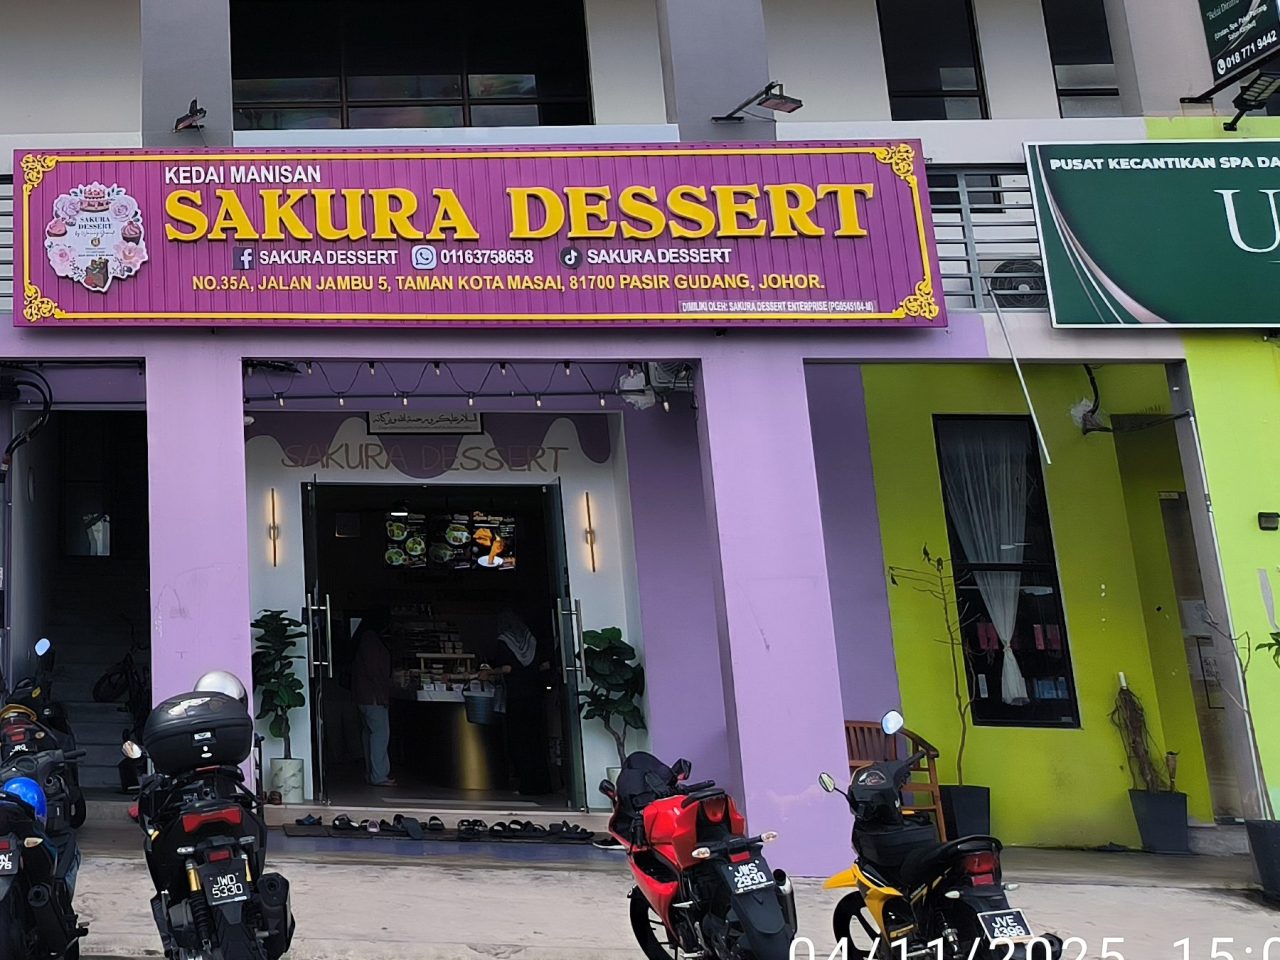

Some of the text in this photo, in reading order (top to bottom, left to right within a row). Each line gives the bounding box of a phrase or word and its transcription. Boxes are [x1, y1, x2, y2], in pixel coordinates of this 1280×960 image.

[1226, 30, 1277, 68] 018 771 9442
[1050, 158, 1104, 170] PUSAT
[1108, 157, 1216, 169] KECANTIKAN
[1219, 156, 1254, 168] SPA
[165, 165, 321, 184] KEDAI MANISAN
[164, 183, 874, 242] SAKURA DESSERT
[259, 249, 398, 265] SAKURA DESSERT
[440, 249, 534, 265] 01163758658
[587, 248, 731, 264] SAKURA DESSERT
[192, 273, 825, 292] NO.35A, JALAN JAMBU 5, TAMAN KOTA MASAI, 81700 PASIR GUDANG, JOHOR.
[729, 302, 756, 312] SAKURA
[757, 302, 786, 312] DESSERT
[787, 301, 827, 311] ENTERPRISE
[281, 442, 570, 473] SAKURA DESSERT
[734, 863, 758, 877] JWS
[213, 874, 236, 888] JWD
[212, 883, 243, 898] 5330
[991, 915, 1017, 928] JVE
